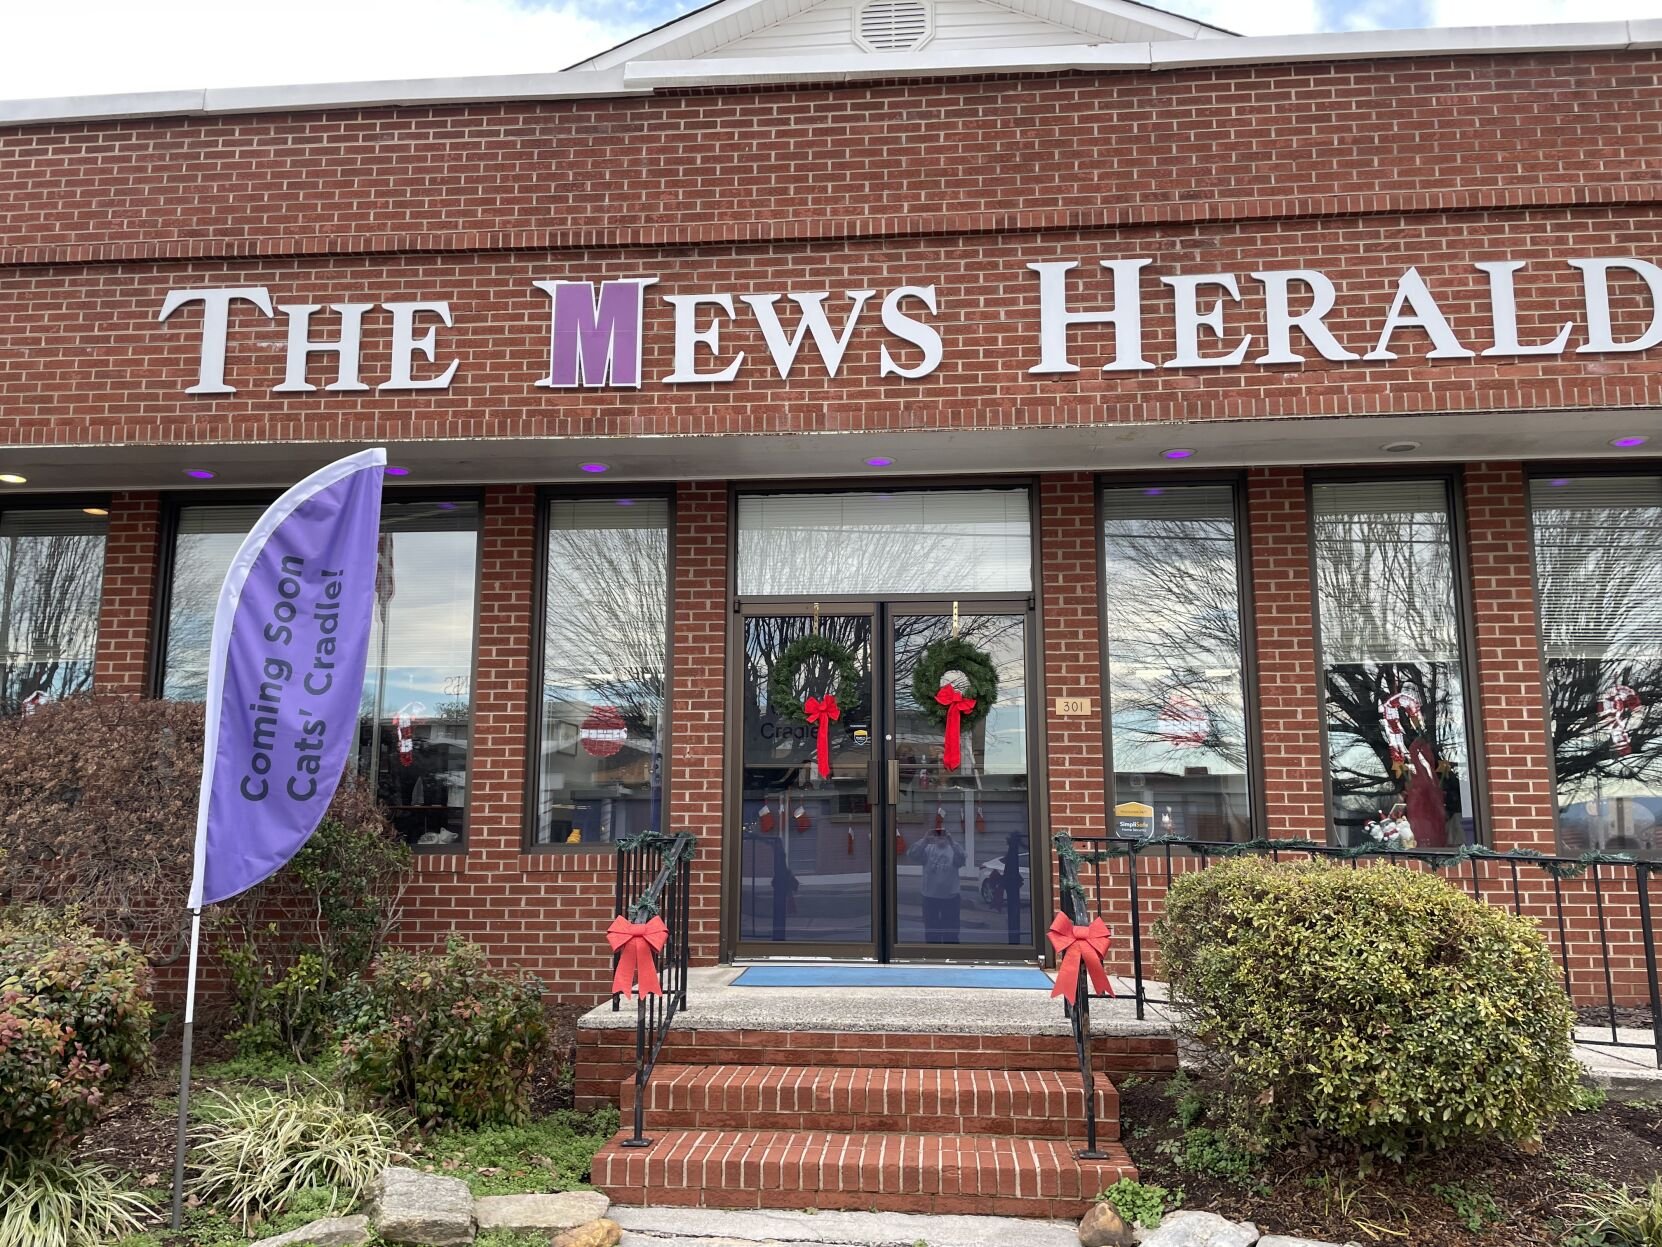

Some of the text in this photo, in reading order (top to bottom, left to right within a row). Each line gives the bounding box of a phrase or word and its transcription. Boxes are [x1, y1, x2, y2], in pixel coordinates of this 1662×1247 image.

[158, 257, 1662, 394] THE MEWS HERALD
[240, 555, 305, 802] Coming Soon
[287, 568, 345, 802] Cats' Cradle!
[1063, 701, 1083, 713] 301
